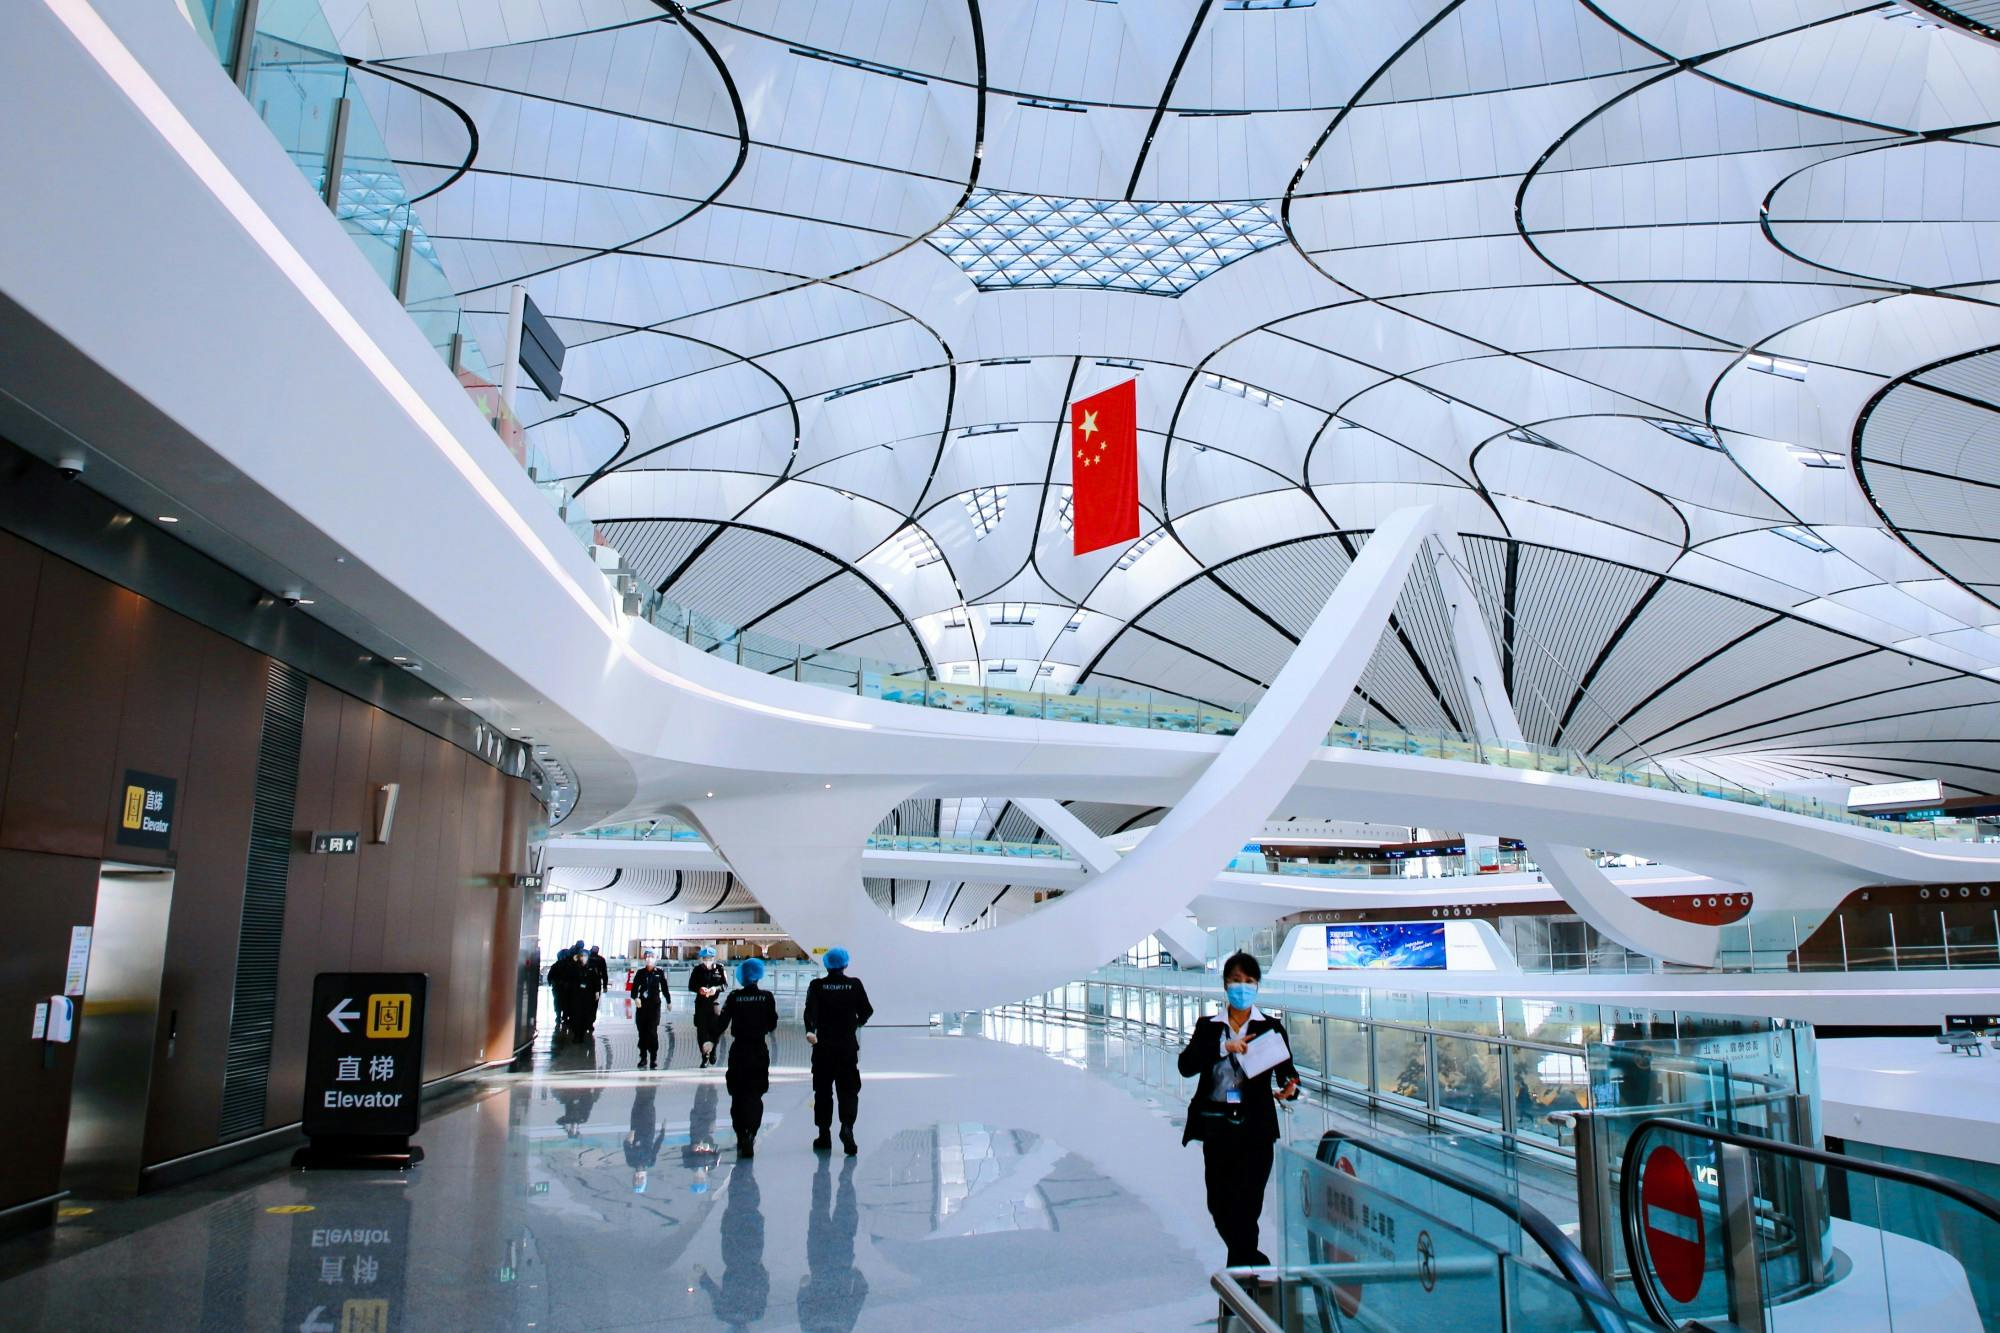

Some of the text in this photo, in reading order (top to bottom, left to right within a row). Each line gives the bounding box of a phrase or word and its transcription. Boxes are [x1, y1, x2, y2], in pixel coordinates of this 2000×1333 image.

[145, 790, 163, 811] 直梯
[143, 816, 169, 832] Elevator
[336, 1056, 394, 1081] 直梯
[324, 1091, 402, 1108] Elevator
